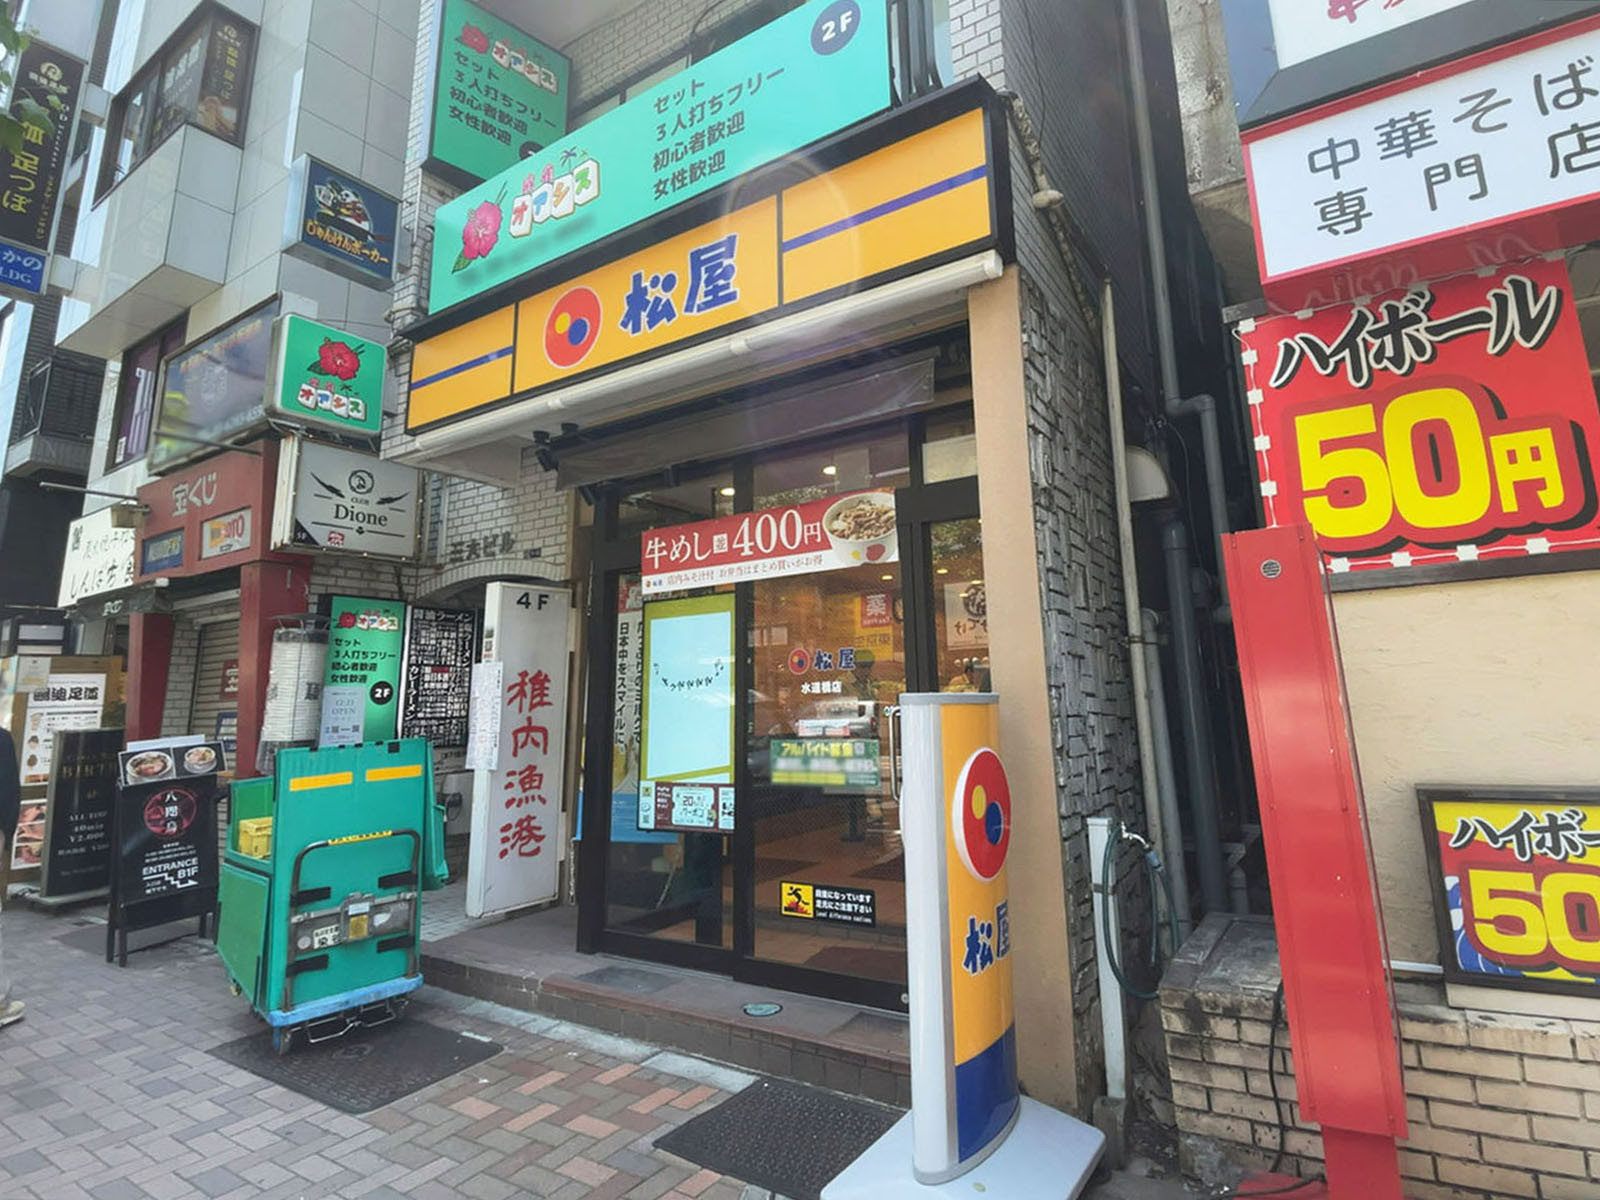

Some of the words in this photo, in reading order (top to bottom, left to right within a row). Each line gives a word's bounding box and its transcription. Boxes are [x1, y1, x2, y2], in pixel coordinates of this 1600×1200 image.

[822, 9, 853, 43] 2F
[454, 51, 500, 81] セット
[493, 43, 556, 92] オアシス
[449, 85, 528, 136] 初心者歓迎
[454, 69, 557, 128] 3人打ちフリー
[653, 78, 706, 115] セット
[655, 67, 785, 142] 3人打ちフリー
[1307, 56, 1600, 182] 中華そば
[448, 105, 512, 147] 女性歓迎
[652, 111, 746, 174] 初心者歓迎
[511, 163, 596, 230] オアシス
[653, 149, 727, 201] 女性歓迎
[619, 232, 739, 336] 松屋
[1269, 275, 1563, 389] ハイボール
[299, 385, 365, 419] オアシス
[1295, 387, 1566, 539] 50円
[171, 472, 218, 518] 宝くじ
[334, 504, 388, 527] Dione
[645, 532, 712, 570] 牛めし
[732, 509, 822, 557] 400円
[357, 615, 399, 631] オアシス
[516, 592, 549, 611] 4F
[334, 638, 361, 648] セット
[334, 650, 396, 660] 3人打ちフリー
[813, 646, 857, 672] 松屋
[374, 688, 390, 698] 2F
[499, 669, 554, 859] 稚内漁港
[142, 857, 199, 876] ENTRANCE
[177, 866, 199, 880] B1F
[1468, 869, 1600, 964] 50
